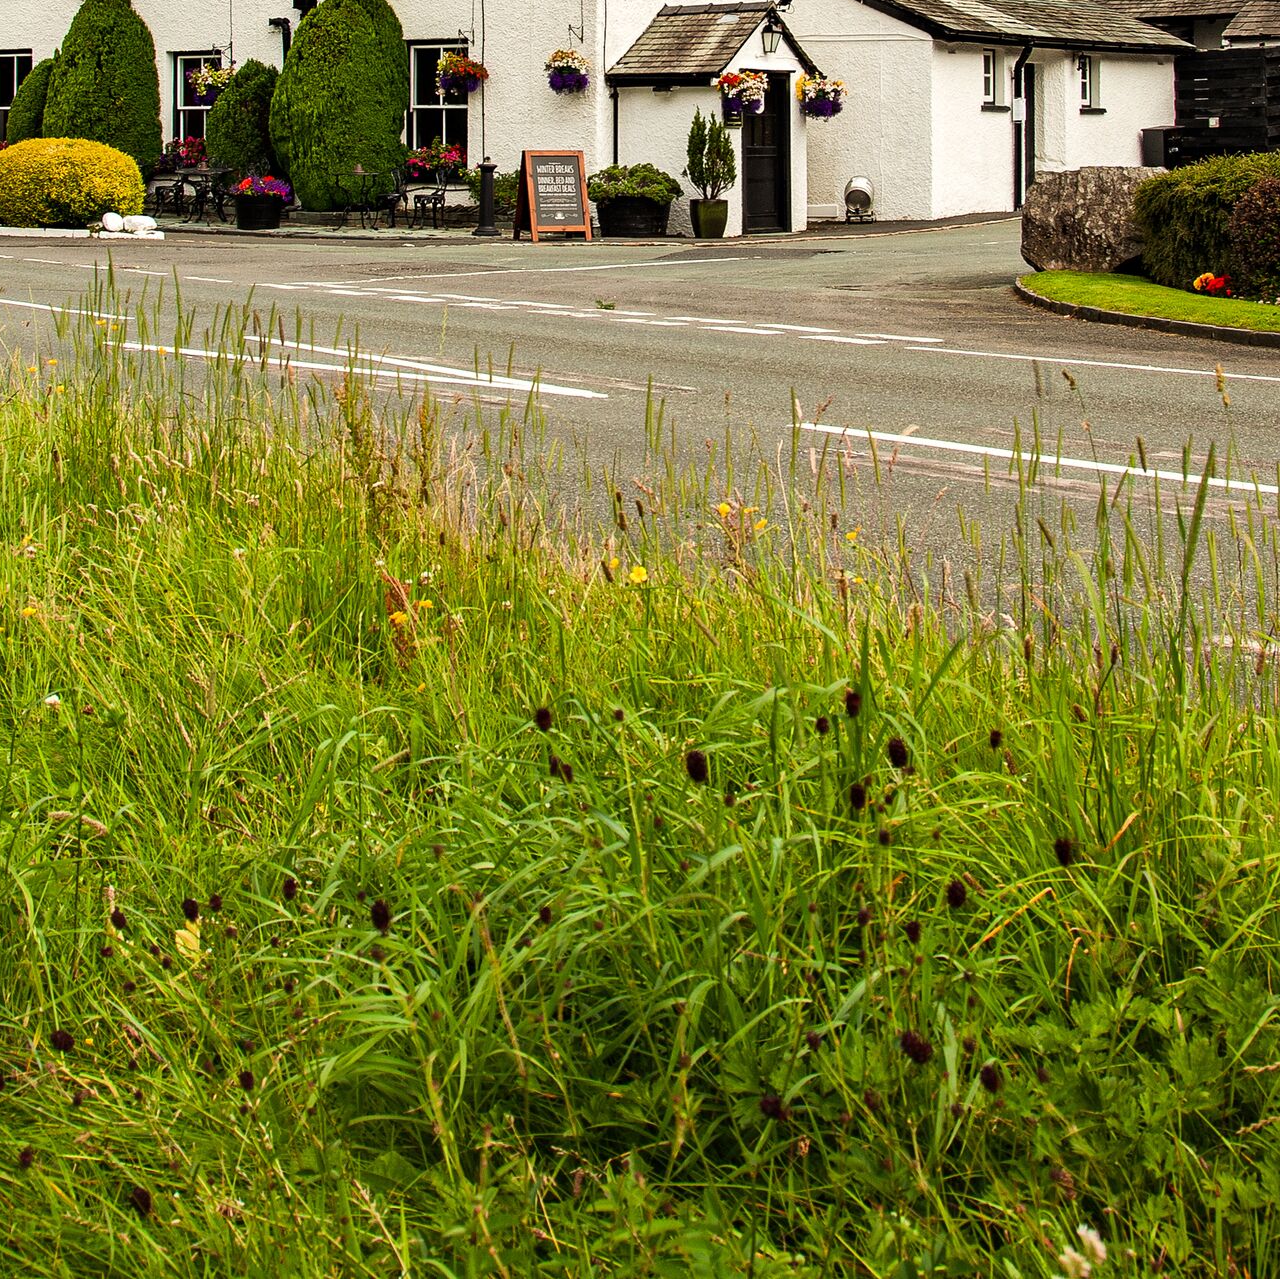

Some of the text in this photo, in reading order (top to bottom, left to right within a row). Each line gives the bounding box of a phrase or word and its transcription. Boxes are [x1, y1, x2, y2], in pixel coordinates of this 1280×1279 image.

[536, 164, 574, 174] WINTER BREAKS
[556, 176, 565, 185] BED
[565, 176, 576, 185] AND
[538, 184, 576, 193] BREAKFAST DEALS
